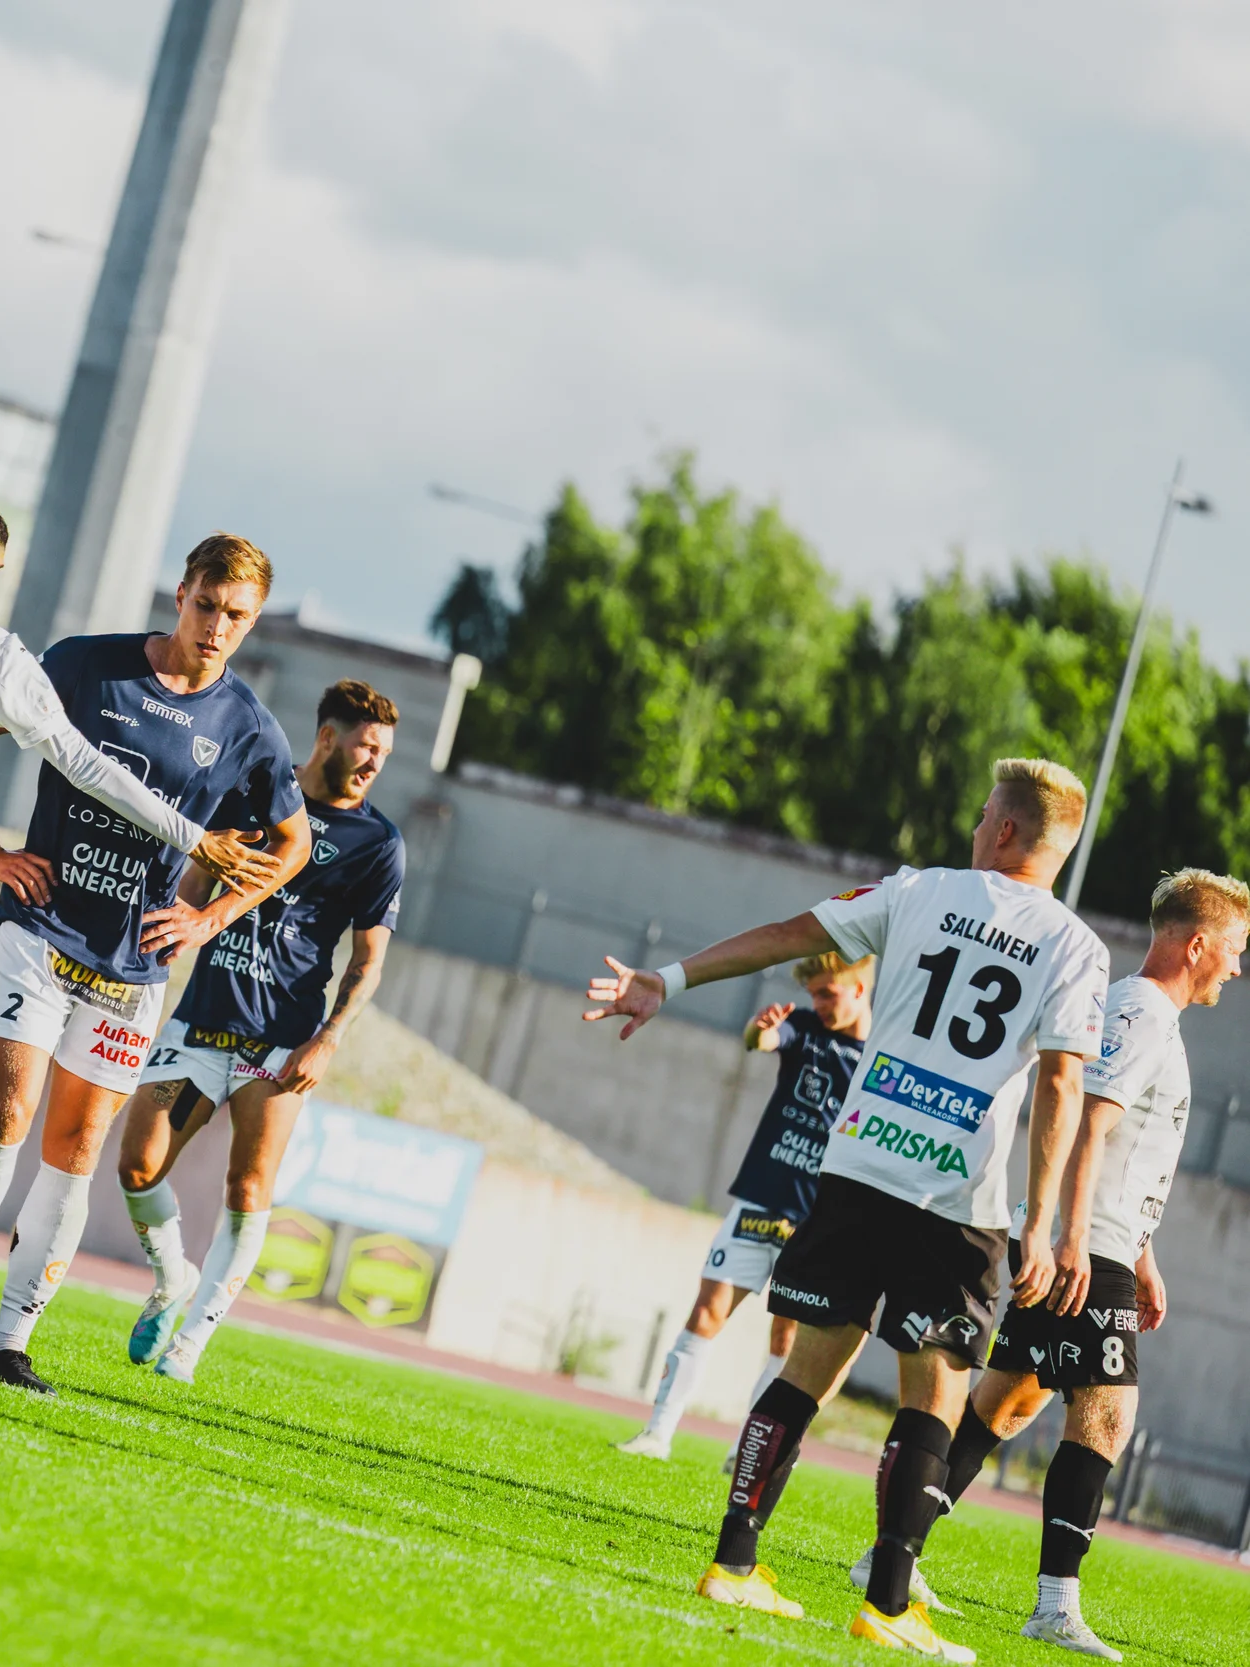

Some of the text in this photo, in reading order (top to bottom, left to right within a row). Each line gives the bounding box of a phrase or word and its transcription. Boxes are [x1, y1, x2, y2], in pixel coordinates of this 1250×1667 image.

[101, 708, 132, 725] CRAFT
[939, 912, 1040, 967] SALLINEN
[0, 992, 24, 1021] 2
[912, 945, 1022, 1060] 13
[93, 1019, 151, 1050] Juhan
[90, 1040, 141, 1068] Auto
[898, 1072, 988, 1127] DevTeks
[910, 1099, 959, 1124] VALKEAKOSKI
[781, 1129, 825, 1160] OULU
[859, 1115, 969, 1179] PRISMA
[770, 1143, 821, 1178] ENERG
[706, 1247, 726, 1268] 0
[1102, 1336, 1125, 1376] 8
